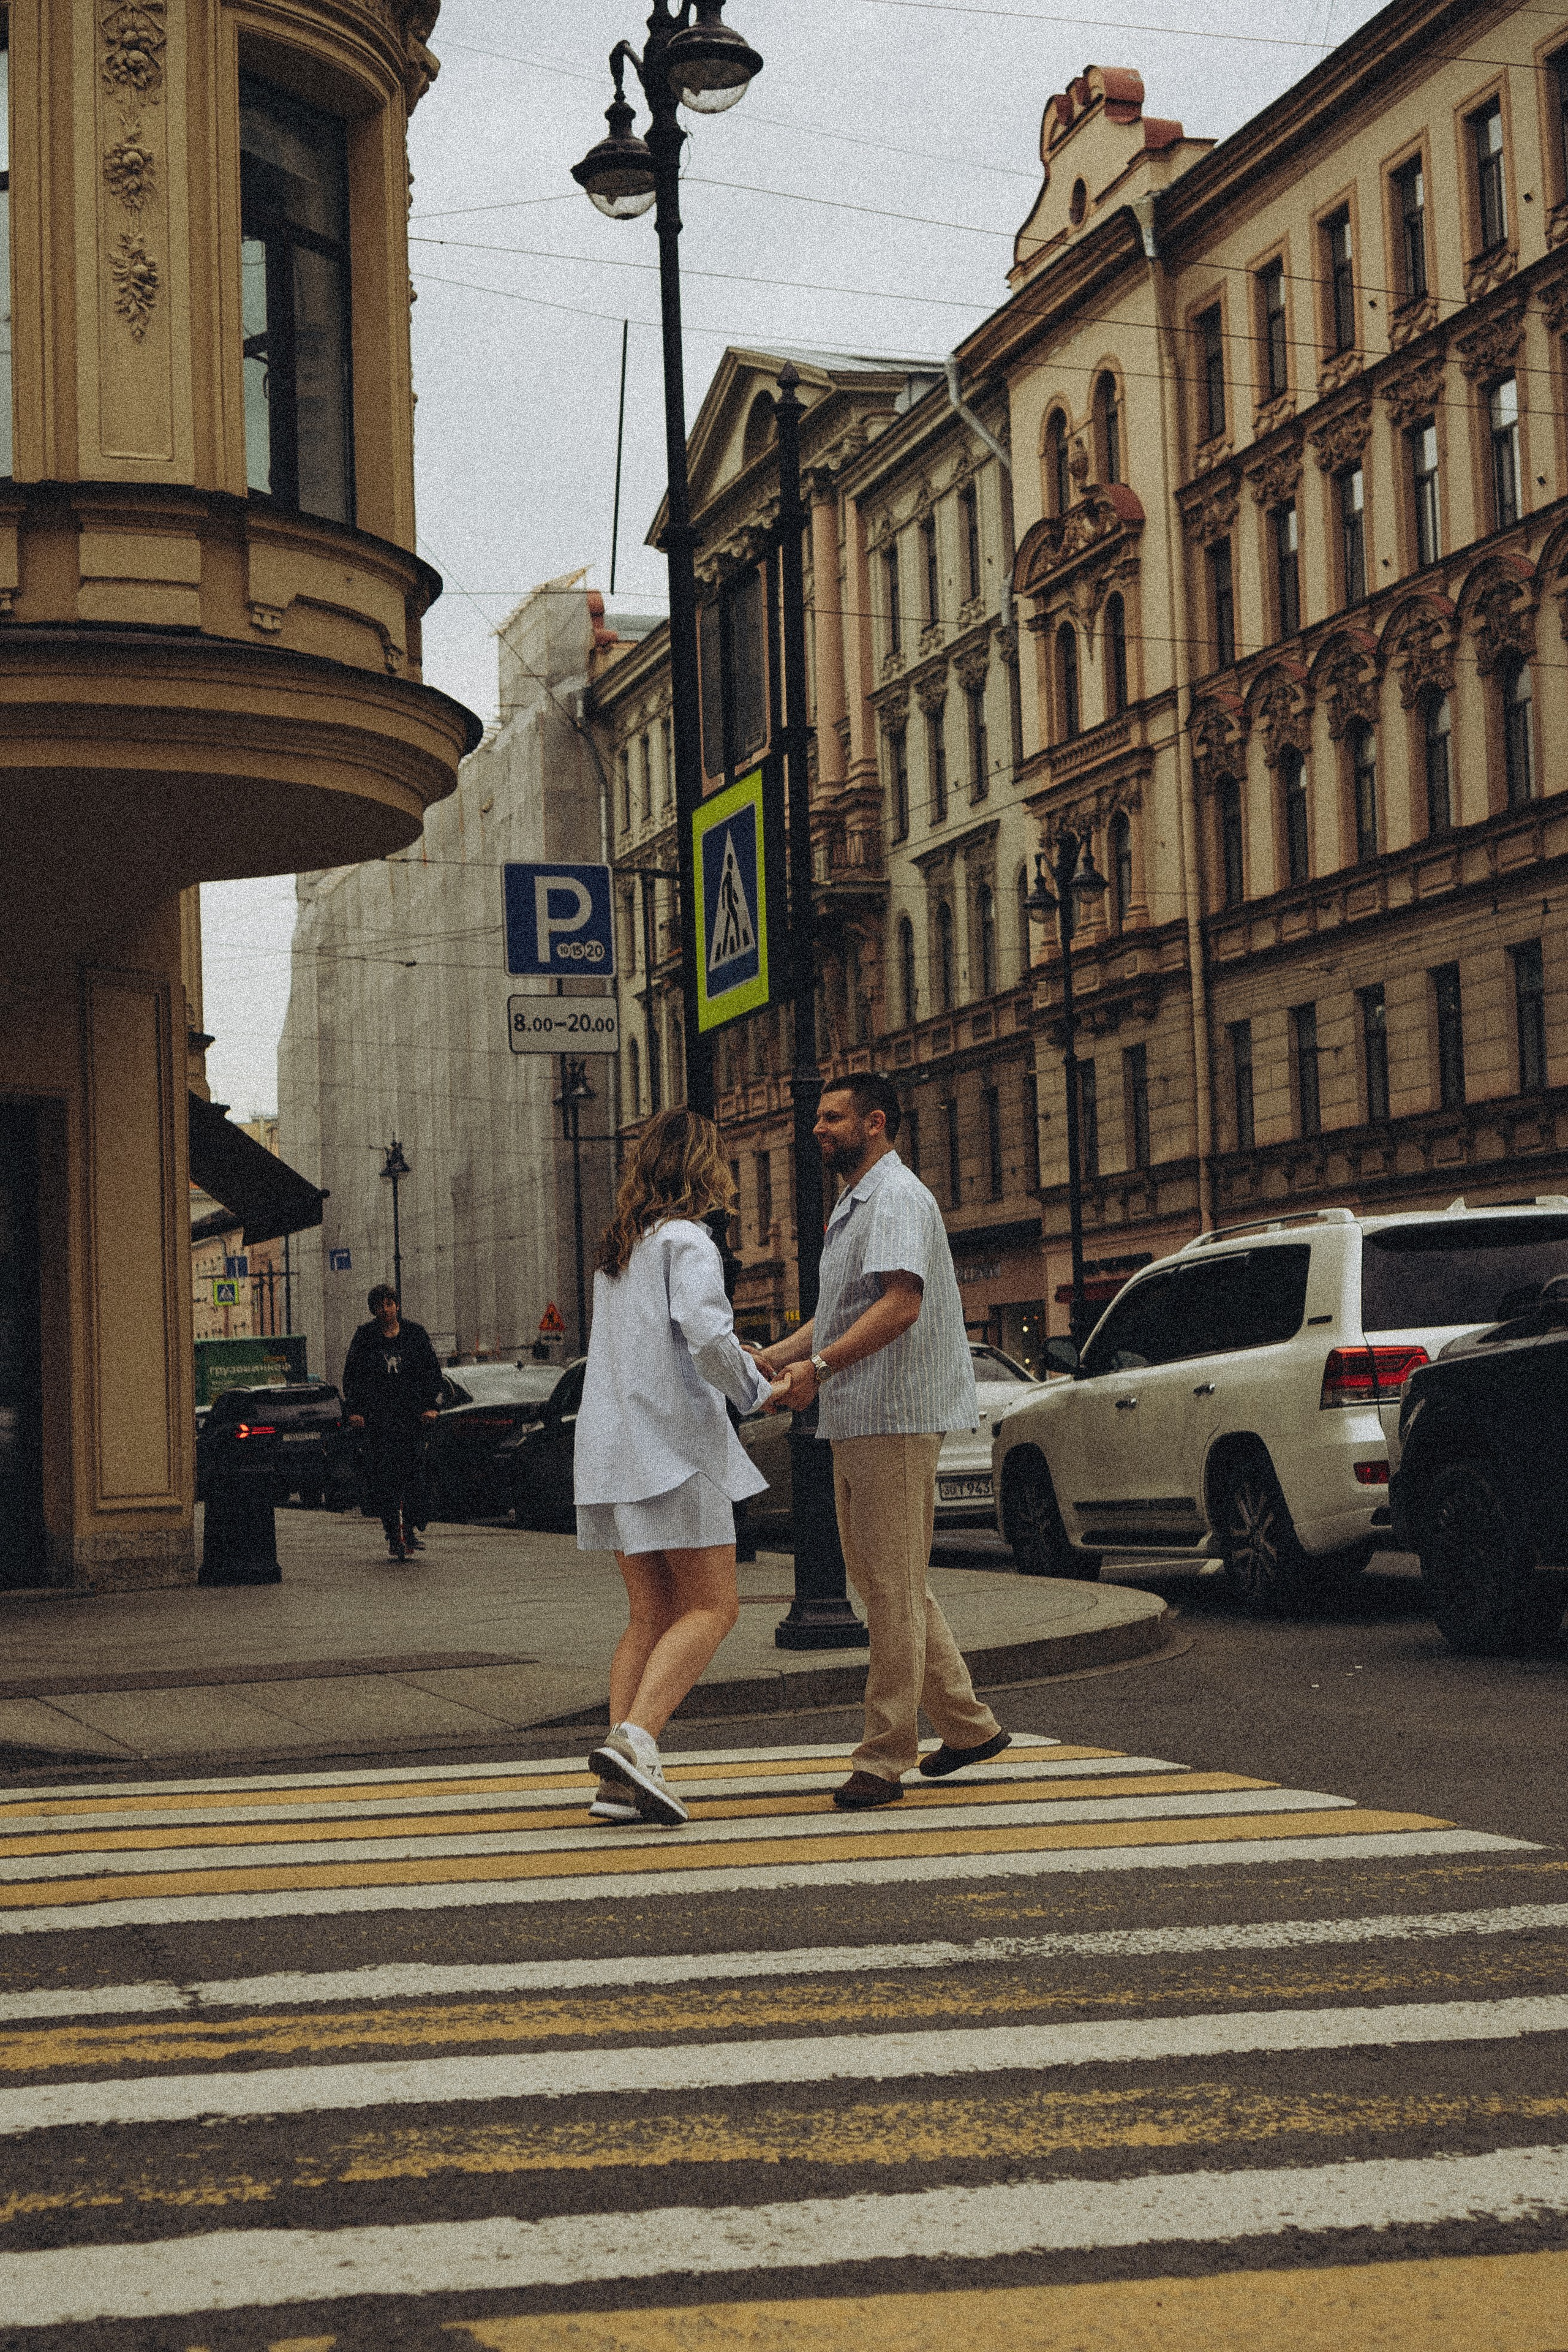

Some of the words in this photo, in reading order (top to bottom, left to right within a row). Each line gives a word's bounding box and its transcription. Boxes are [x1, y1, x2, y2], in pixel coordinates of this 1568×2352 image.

[535, 875, 592, 963] P
[559, 944, 569, 956] 10
[573, 944, 583, 957] 15
[586, 944, 603, 957] 20
